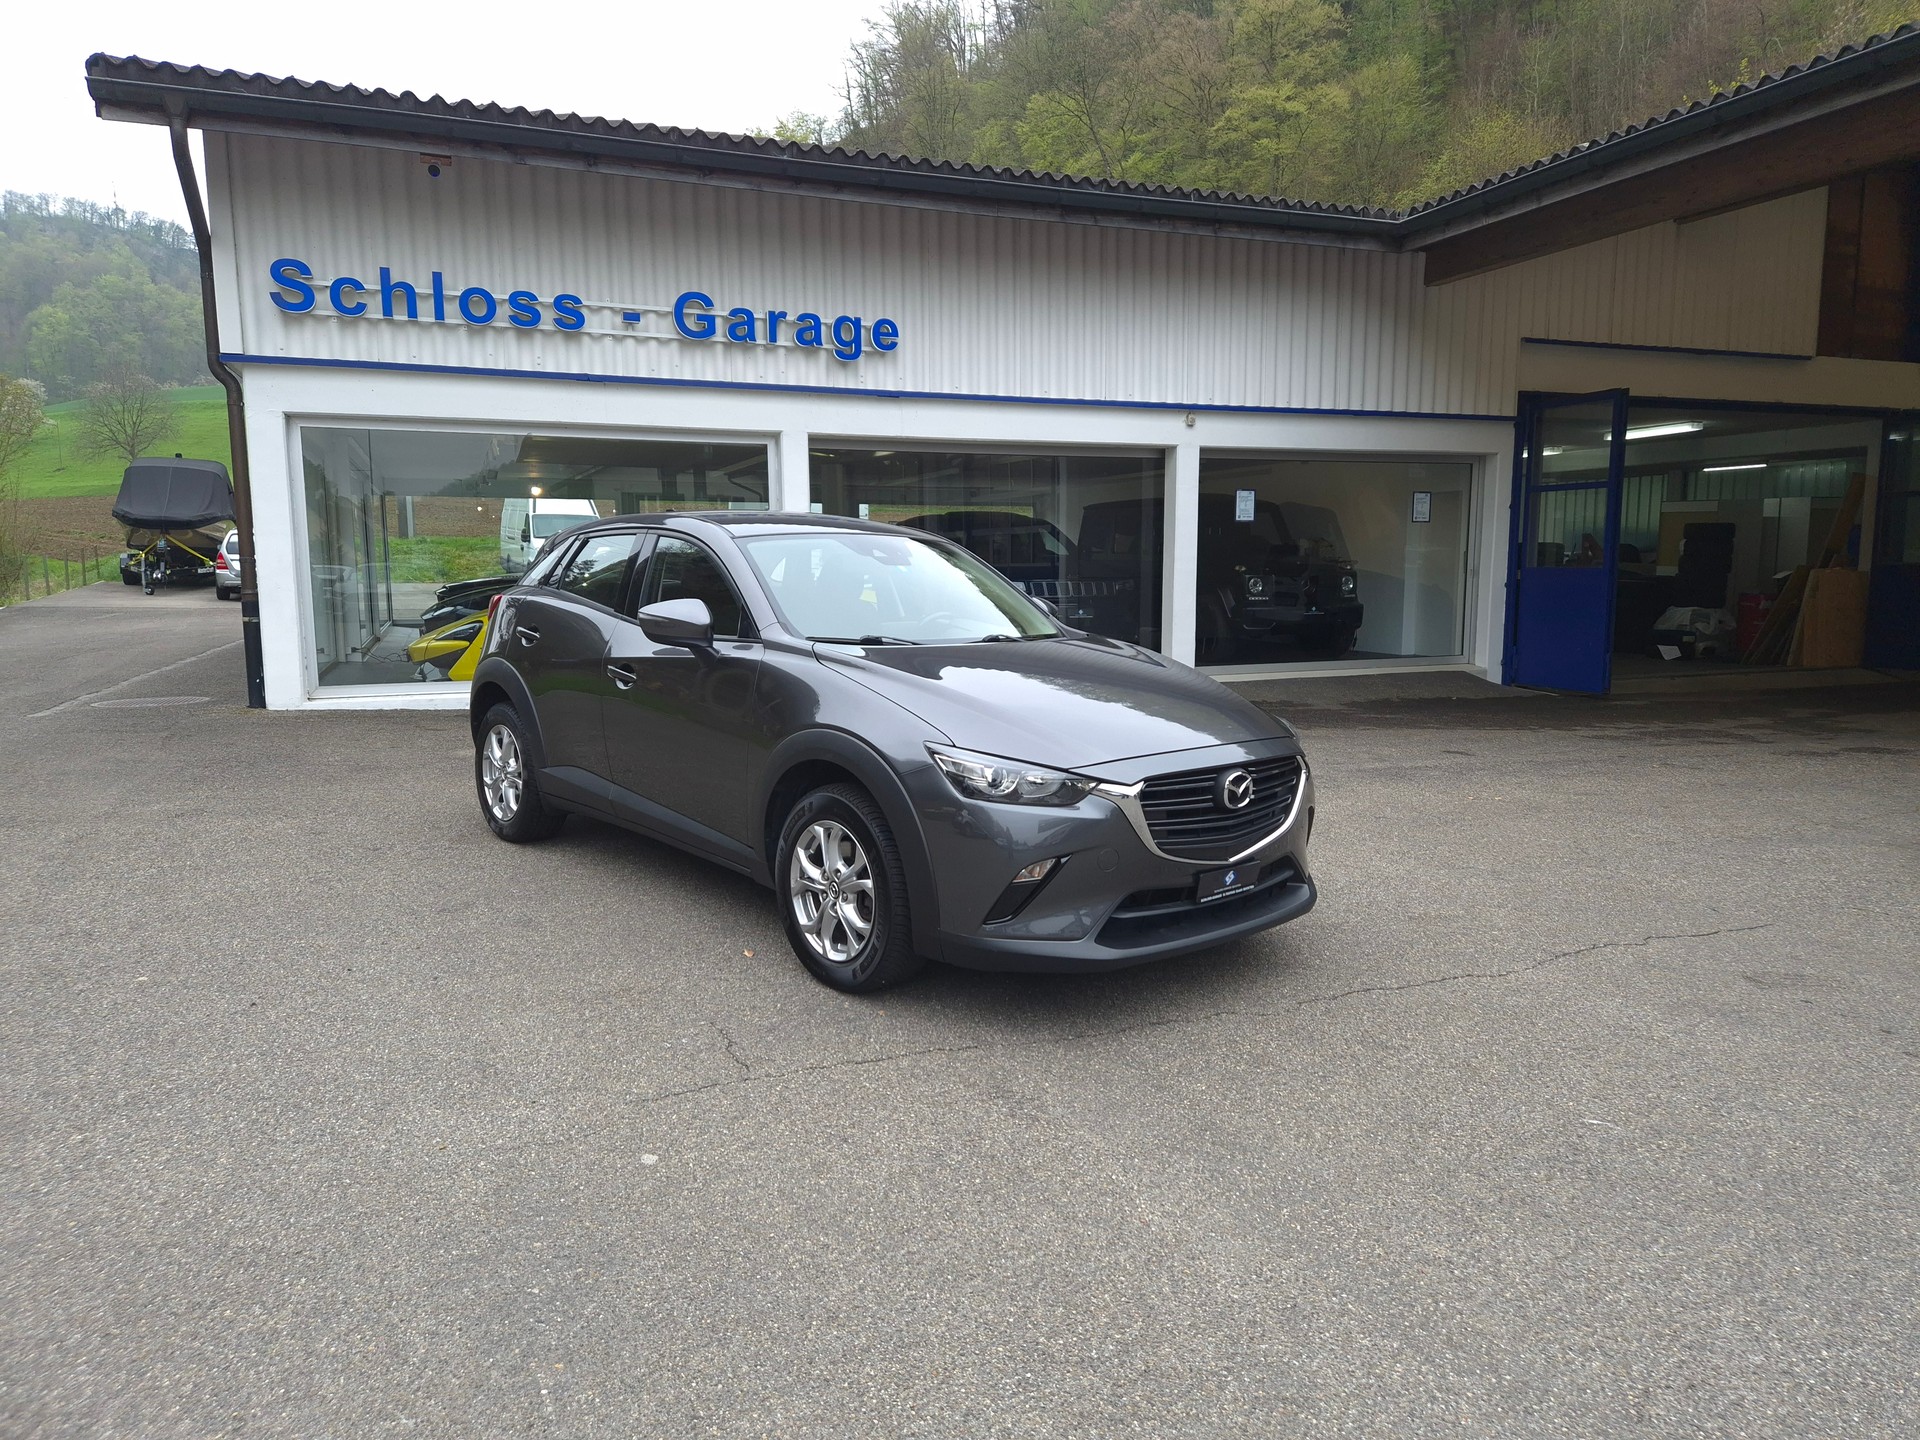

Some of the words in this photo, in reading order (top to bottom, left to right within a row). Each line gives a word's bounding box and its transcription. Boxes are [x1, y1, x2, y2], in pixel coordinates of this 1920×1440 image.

[269, 257, 587, 331] Schloss
[622, 312, 642, 323] -
[673, 291, 900, 362] Garage
